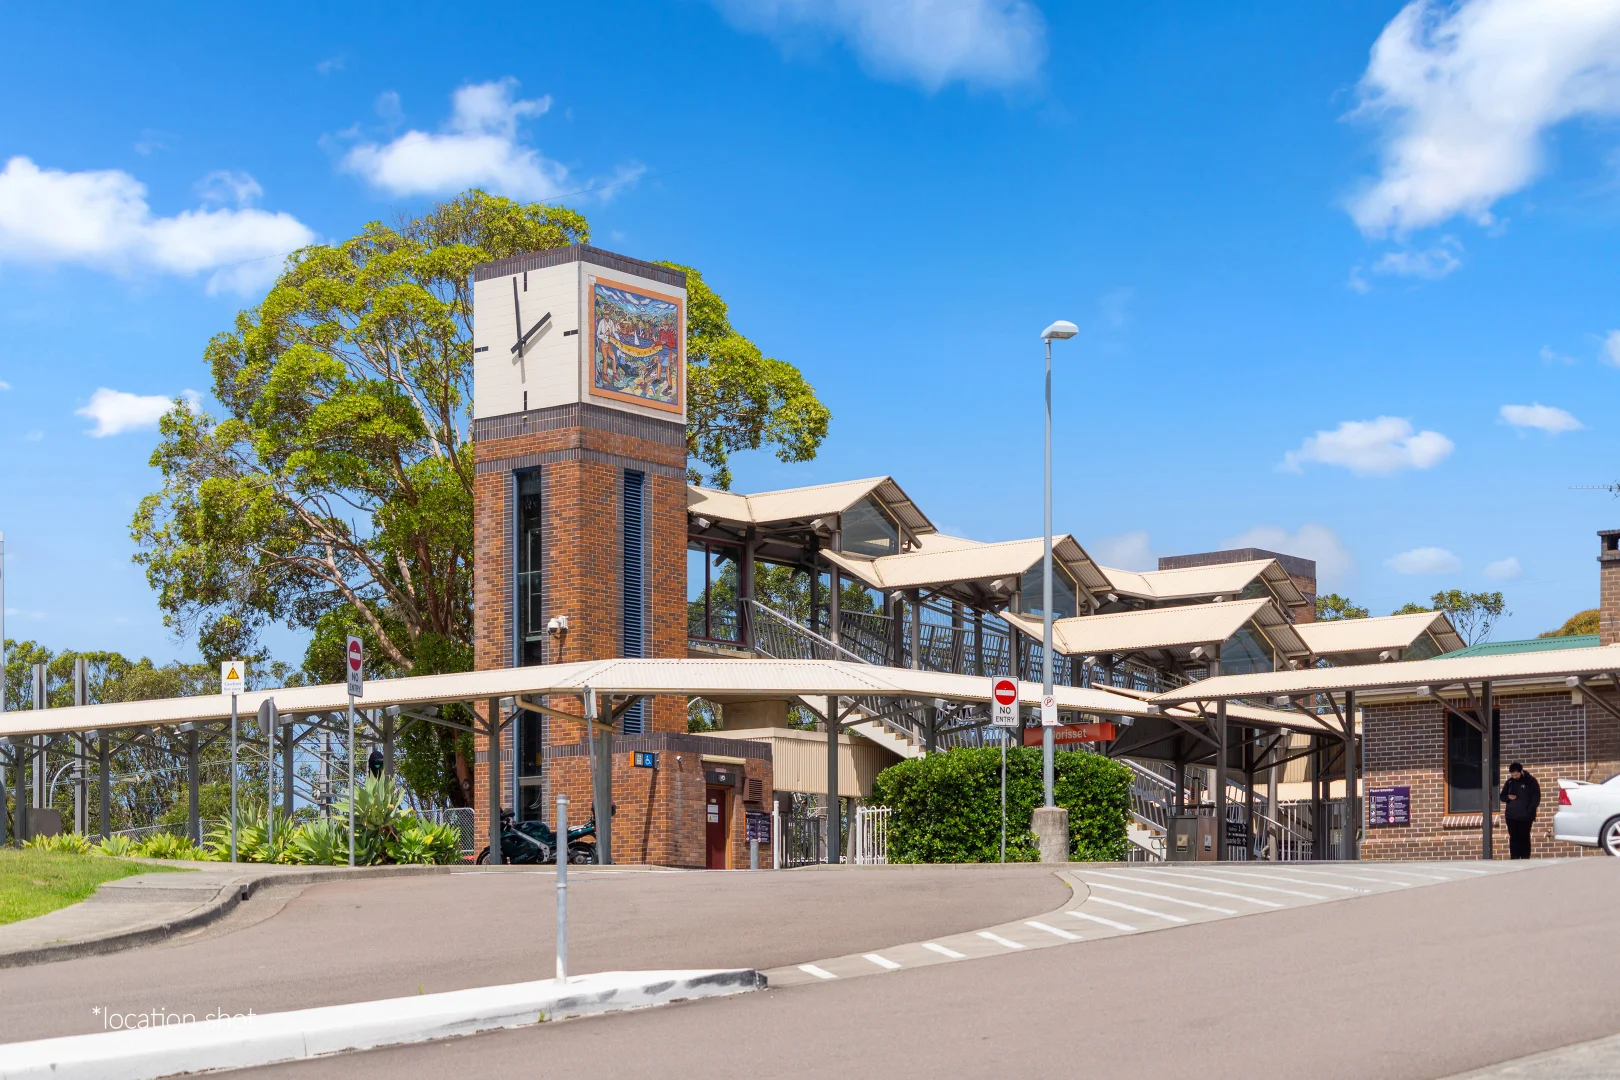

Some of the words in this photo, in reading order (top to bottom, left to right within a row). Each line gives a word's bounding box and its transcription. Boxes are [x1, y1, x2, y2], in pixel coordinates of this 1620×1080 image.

[352, 672, 359, 681] NO
[350, 683, 361, 692] ENTRY
[1000, 706, 1012, 715] NO
[1054, 728, 1087, 740] orisset
